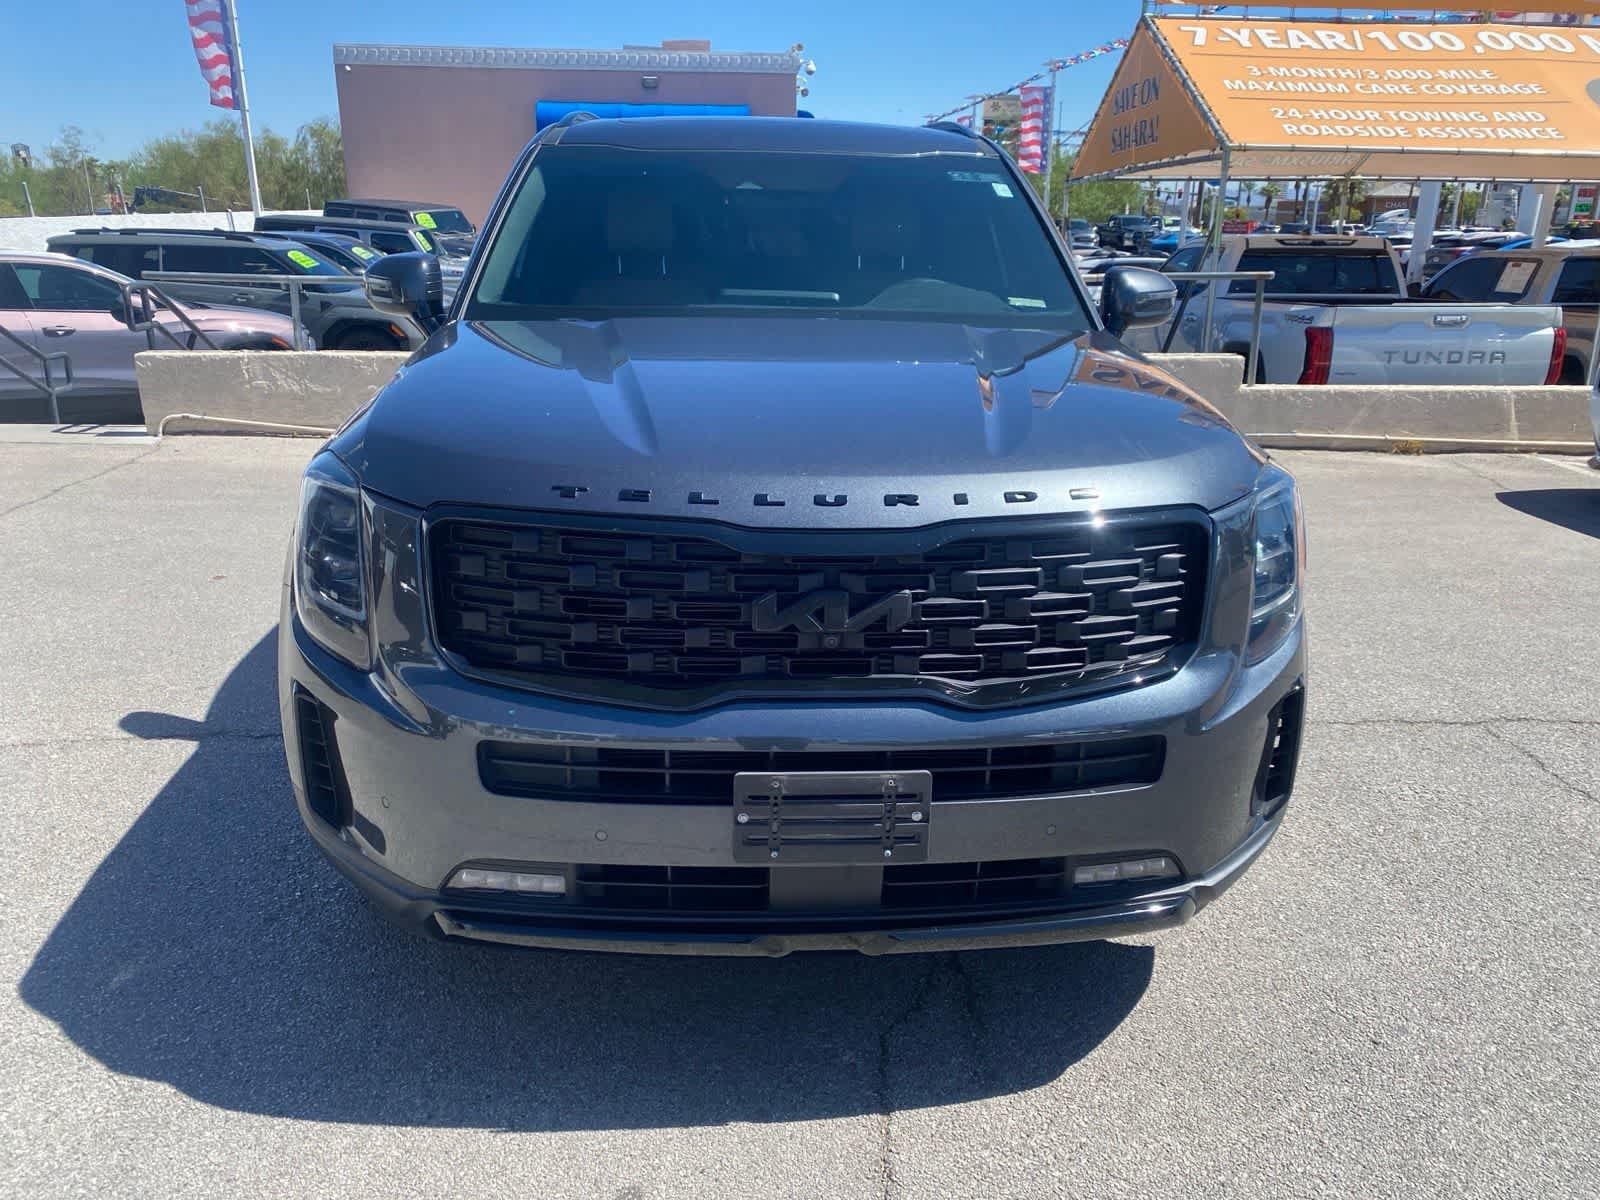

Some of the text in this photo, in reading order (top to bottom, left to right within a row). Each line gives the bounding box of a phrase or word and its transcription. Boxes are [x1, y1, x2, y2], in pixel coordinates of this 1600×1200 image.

[1179, 25, 1576, 54] 7-YEAR/100,000
[1245, 65, 1498, 81] 3-MONTH/3,000-MILE
[1112, 77, 1159, 116] SAVE ON
[1223, 79, 1547, 96] MAXIMUM CARE COVERAGE
[1270, 107, 1547, 123] 24-HOUR TOWING AND
[1111, 115, 1160, 154] SAHARA!
[1282, 123, 1565, 140] ROADSIDE ASSISTANCE
[1383, 349, 1507, 366] TUNDRA
[551, 484, 1101, 508] TELLURIDE
[751, 588, 913, 632] KIA
